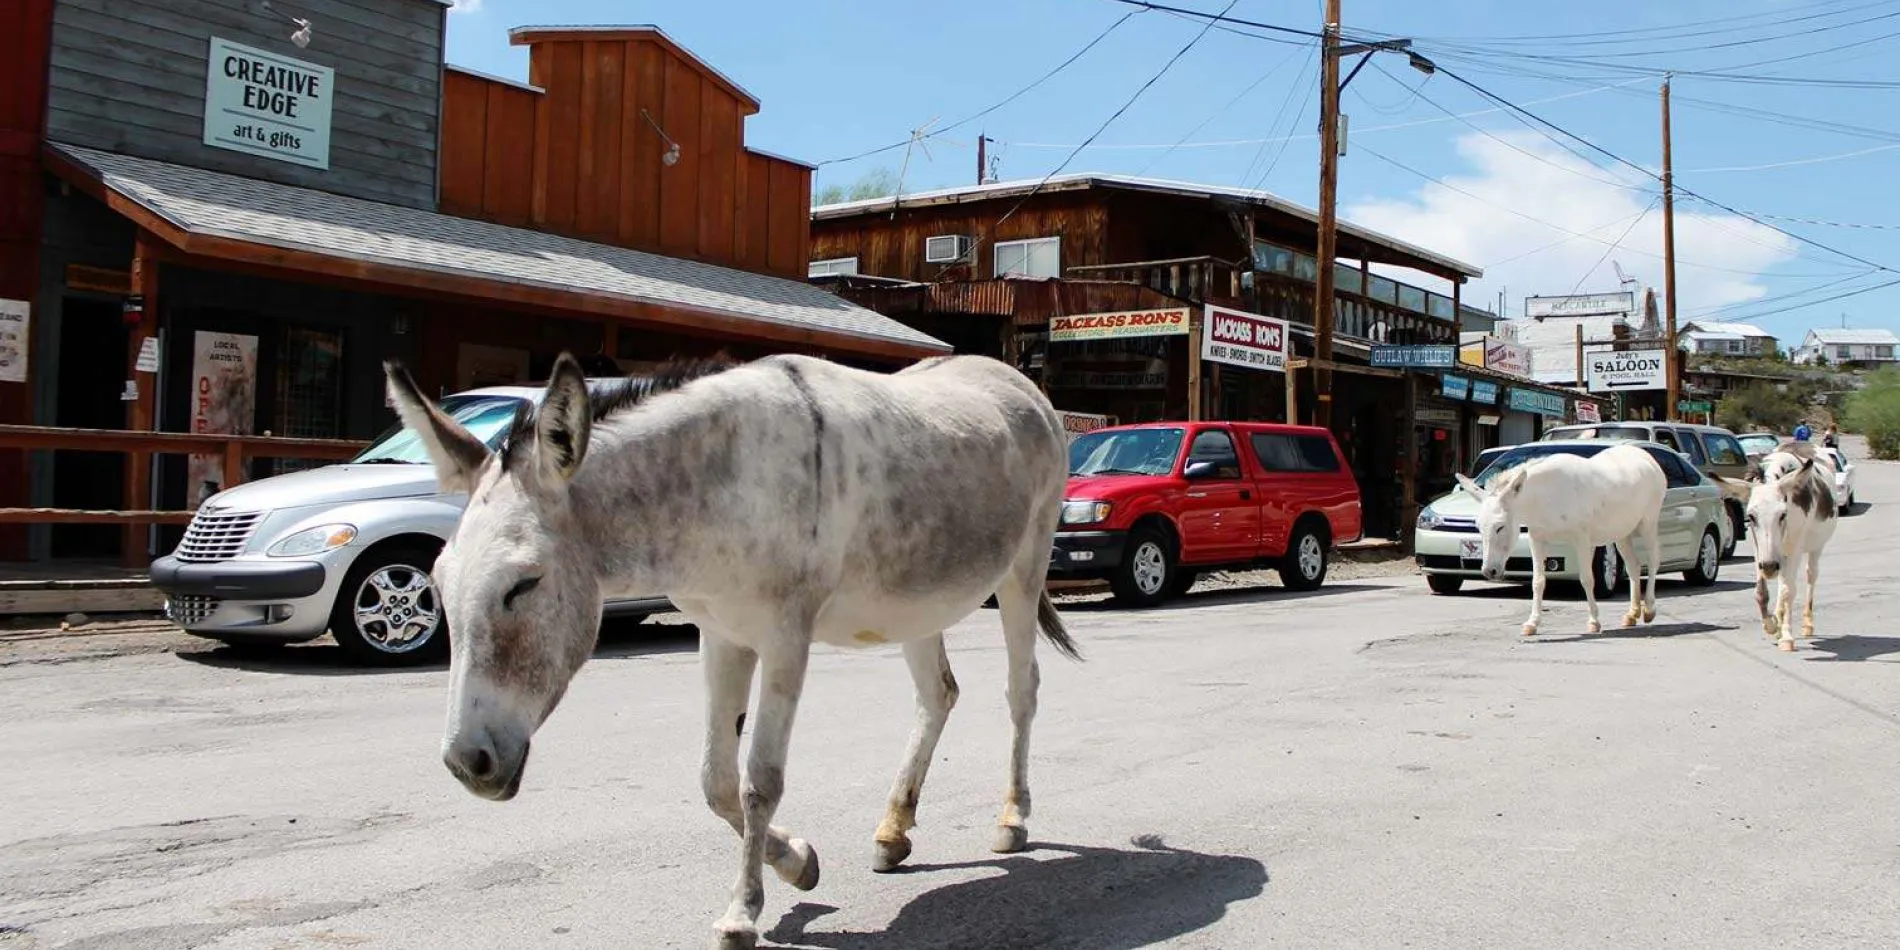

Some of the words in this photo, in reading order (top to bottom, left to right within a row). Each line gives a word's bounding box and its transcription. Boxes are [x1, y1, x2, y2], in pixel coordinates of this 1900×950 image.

[224, 56, 319, 98] CREATIVE
[243, 85, 298, 118] EDGE
[233, 125, 252, 139] art
[256, 127, 265, 142] &
[269, 131, 301, 149] gifts
[1052, 314, 1127, 331] JACKASS
[1128, 311, 1184, 326] RON'S
[1214, 316, 1252, 342] JACKASS
[1256, 324, 1280, 348] RON'S
[214, 341, 240, 350] LOCAL
[1210, 345, 1227, 358] KNIVES
[1230, 347, 1247, 361] SWORDS
[209, 353, 242, 363] ARTISTS
[1374, 350, 1411, 363] OUTLAW
[1594, 359, 1660, 373] SALOON
